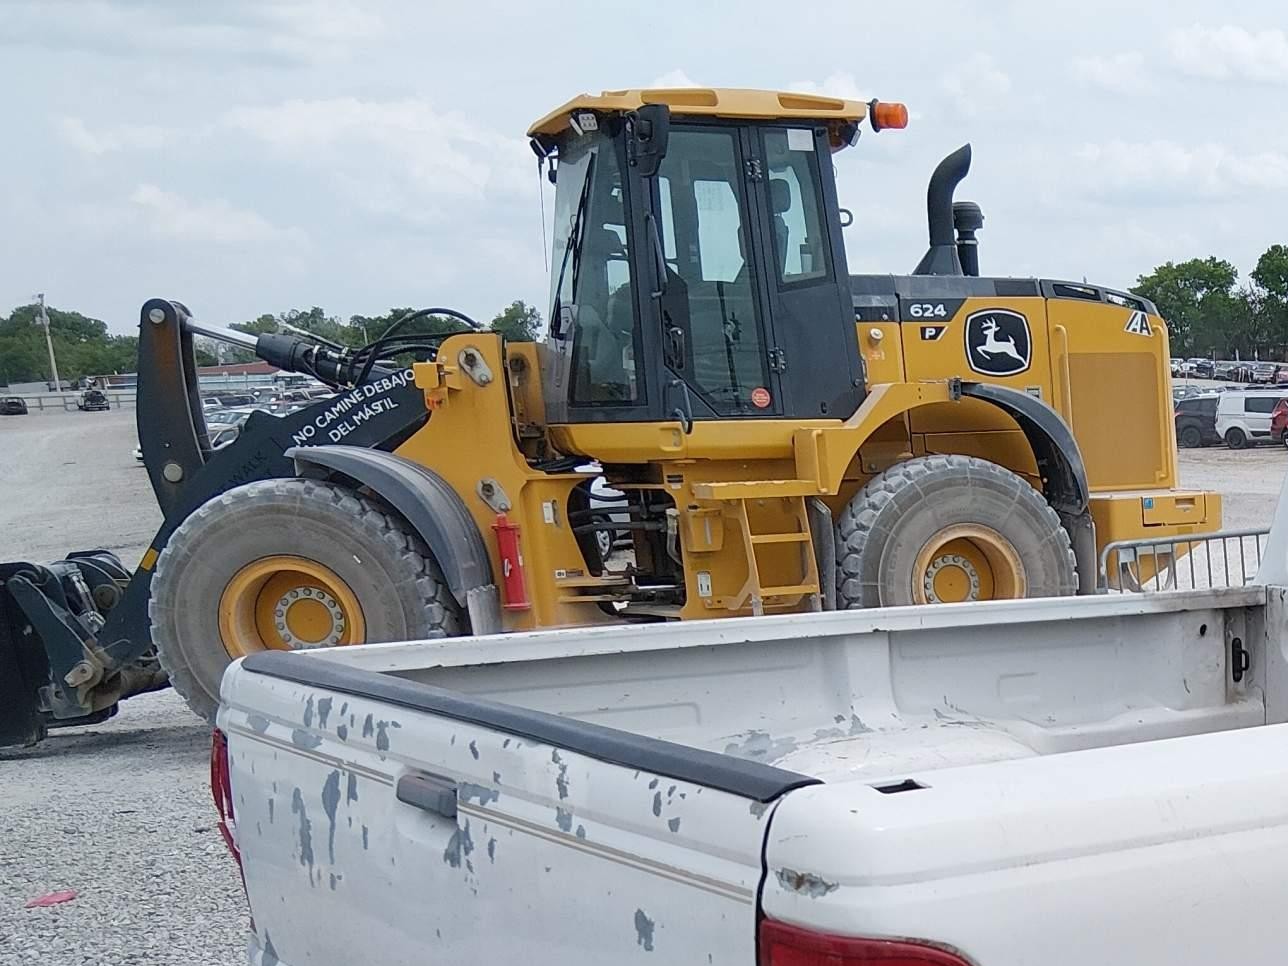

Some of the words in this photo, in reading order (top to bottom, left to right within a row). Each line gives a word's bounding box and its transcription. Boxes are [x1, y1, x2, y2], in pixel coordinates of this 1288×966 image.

[910, 304, 947, 317] 624
[925, 327, 936, 339] P
[293, 425, 316, 445] NO
[316, 389, 364, 428] CAMINE
[363, 369, 415, 397] DEBAJO
[328, 421, 356, 442] DEL
[352, 397, 399, 426] MÁSTIL
